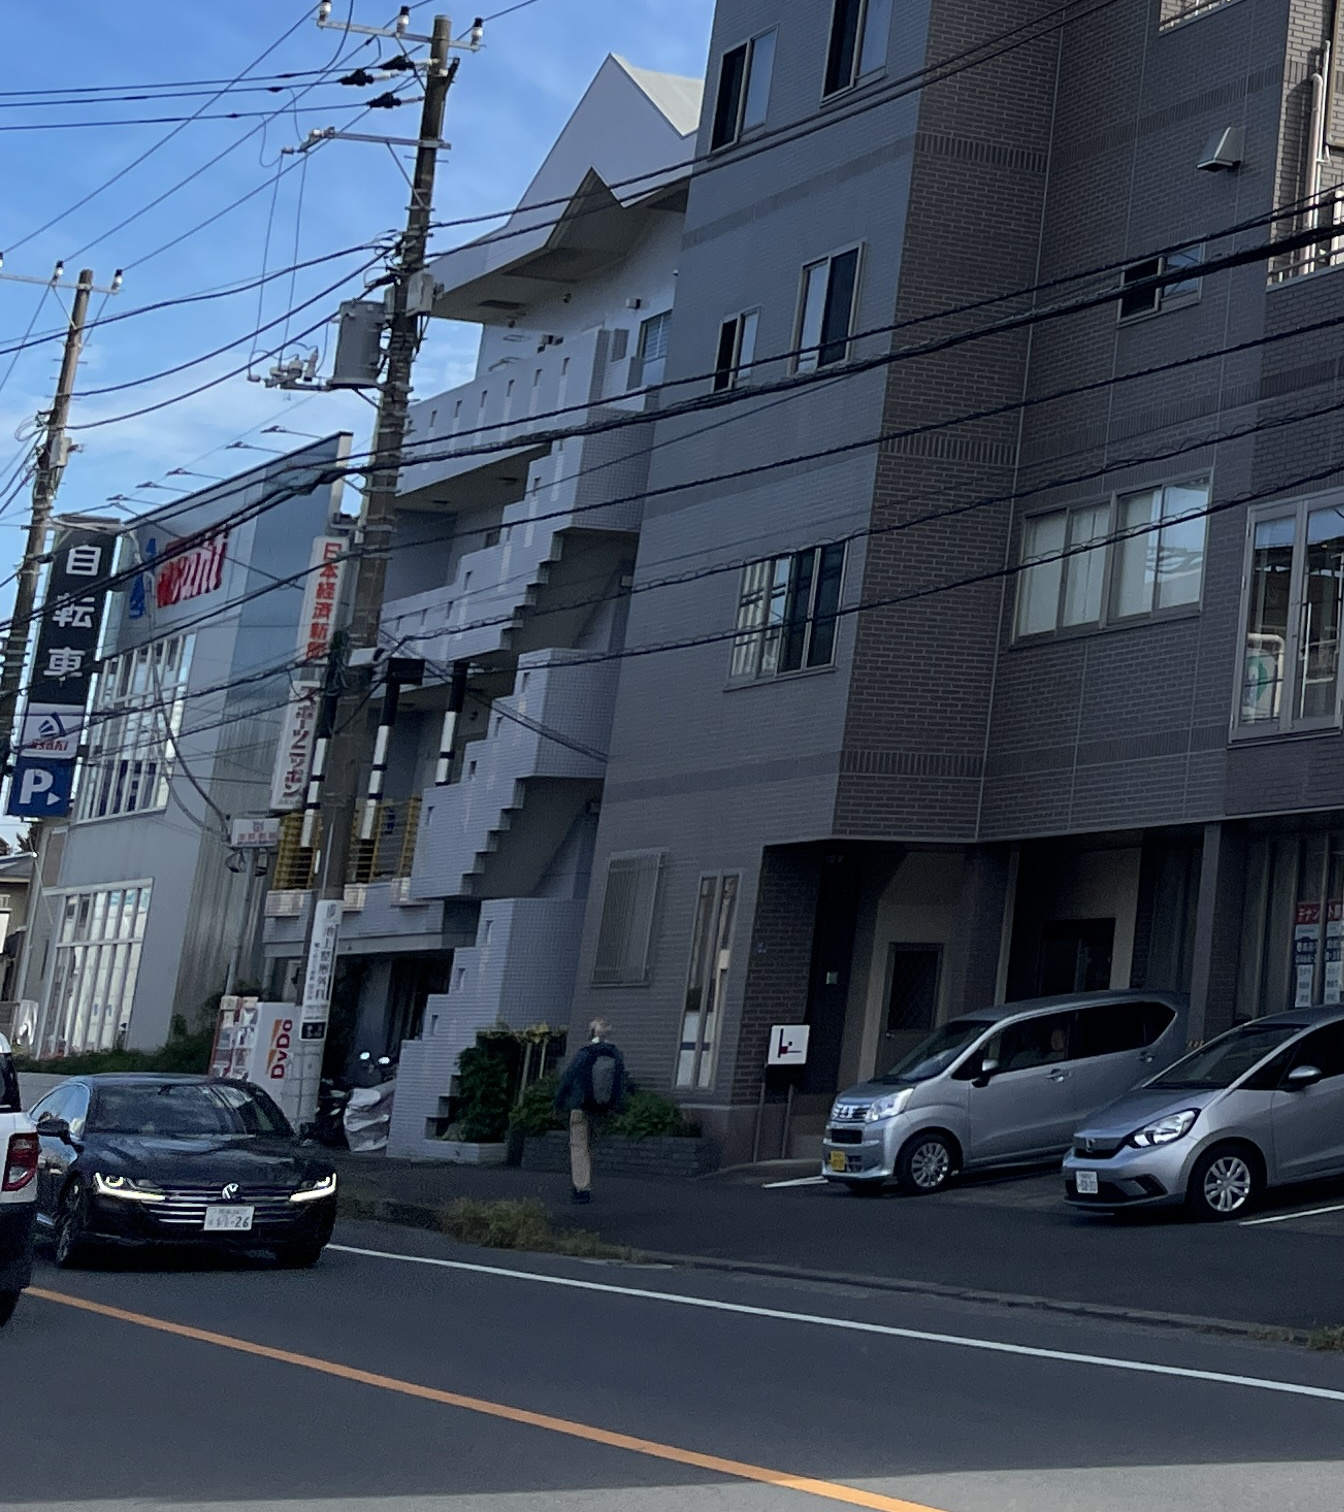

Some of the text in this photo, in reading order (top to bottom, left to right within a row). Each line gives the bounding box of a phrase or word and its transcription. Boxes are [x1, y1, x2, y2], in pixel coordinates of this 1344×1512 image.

[43, 544, 102, 687] 自転車
[19, 768, 54, 806] P
